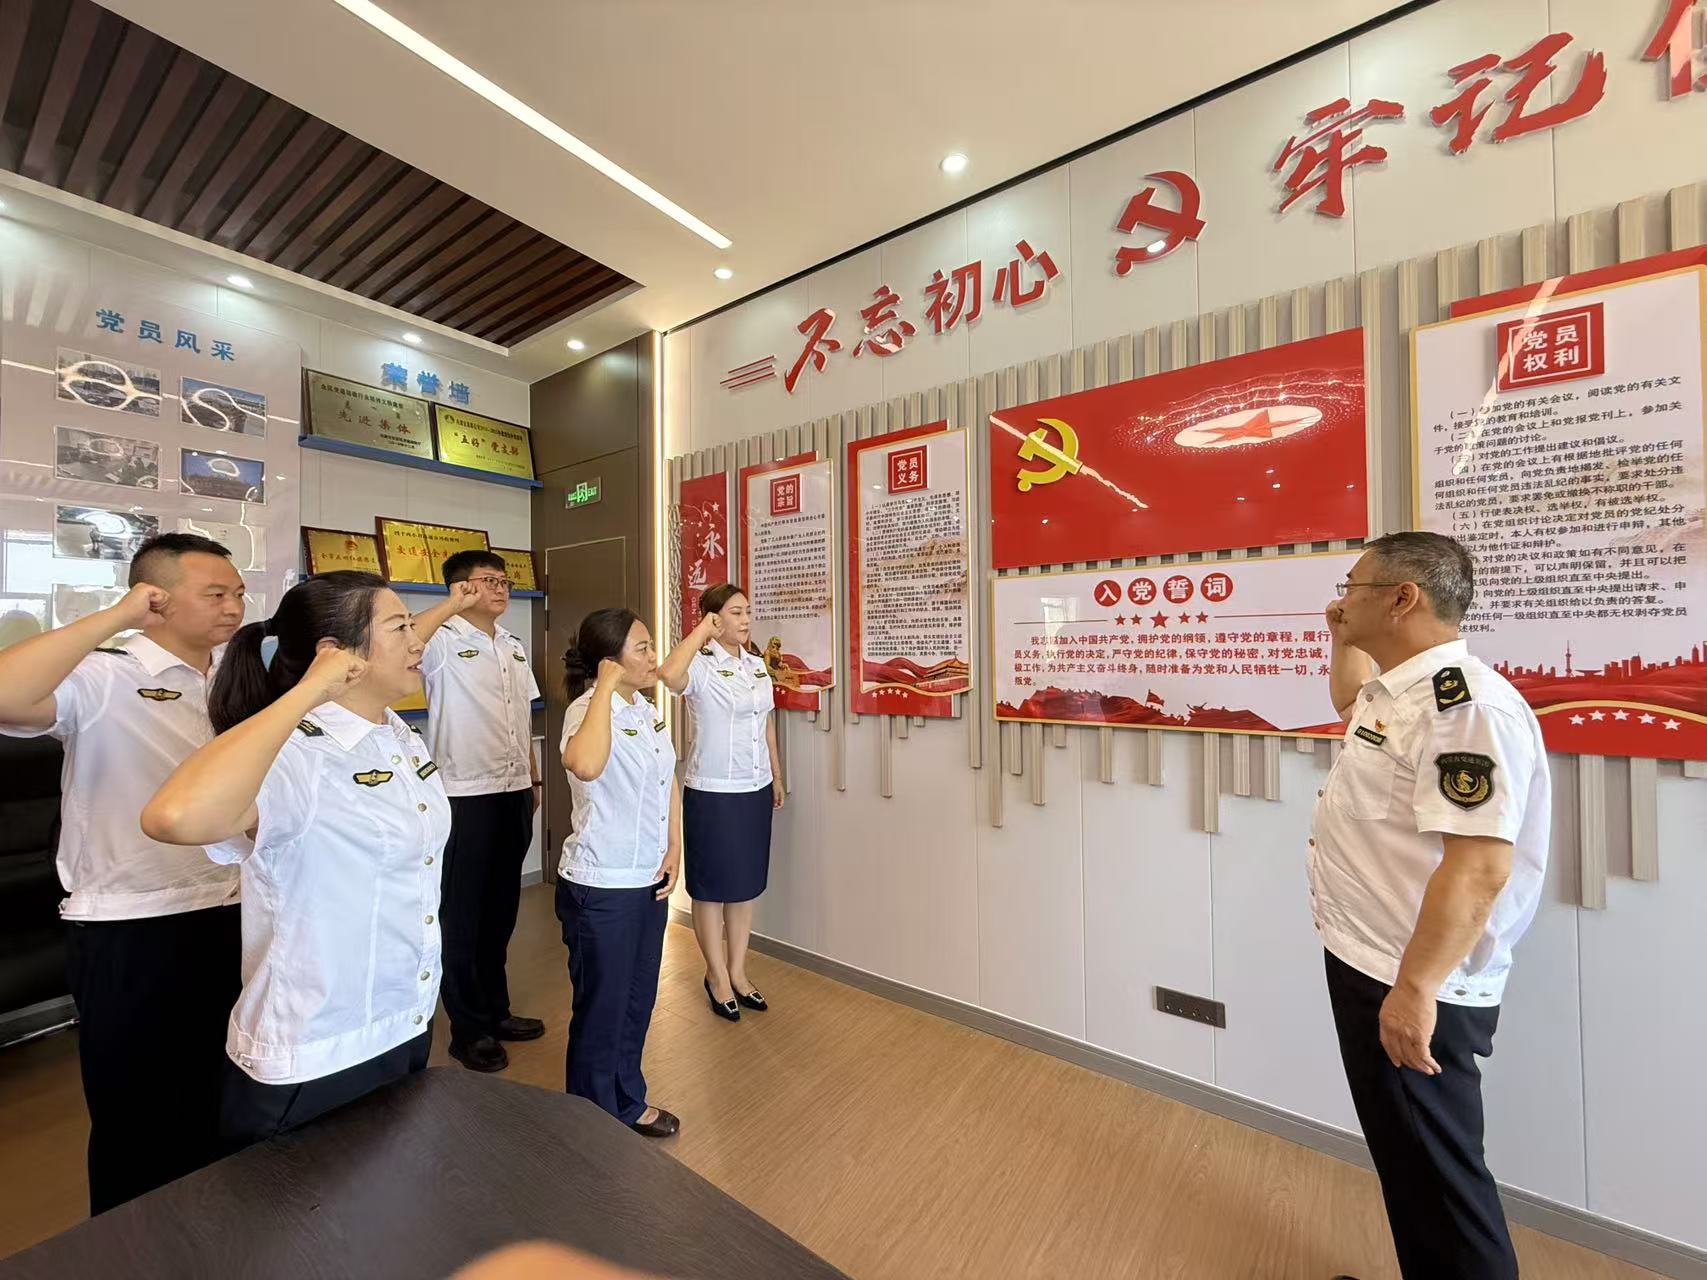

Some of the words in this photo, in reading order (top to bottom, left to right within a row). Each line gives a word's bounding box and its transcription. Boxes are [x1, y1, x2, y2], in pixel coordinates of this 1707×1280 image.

[785, 239, 1061, 394] 不忘初心
[96, 308, 234, 361] 党员风采
[1523, 324, 1579, 351] 党员
[1523, 348, 1579, 372] 权利
[1434, 407, 1559, 433] 件，接受的教育和培训。
[1434, 433, 1547, 454] 于党的策问题的讨论。
[897, 457, 918, 471] 党员
[897, 470, 919, 484] 义务
[1447, 516, 1687, 542] 出鉴定时，本人有权参加和进行申辩，其他
[1099, 577, 1228, 602] 入党誓词
